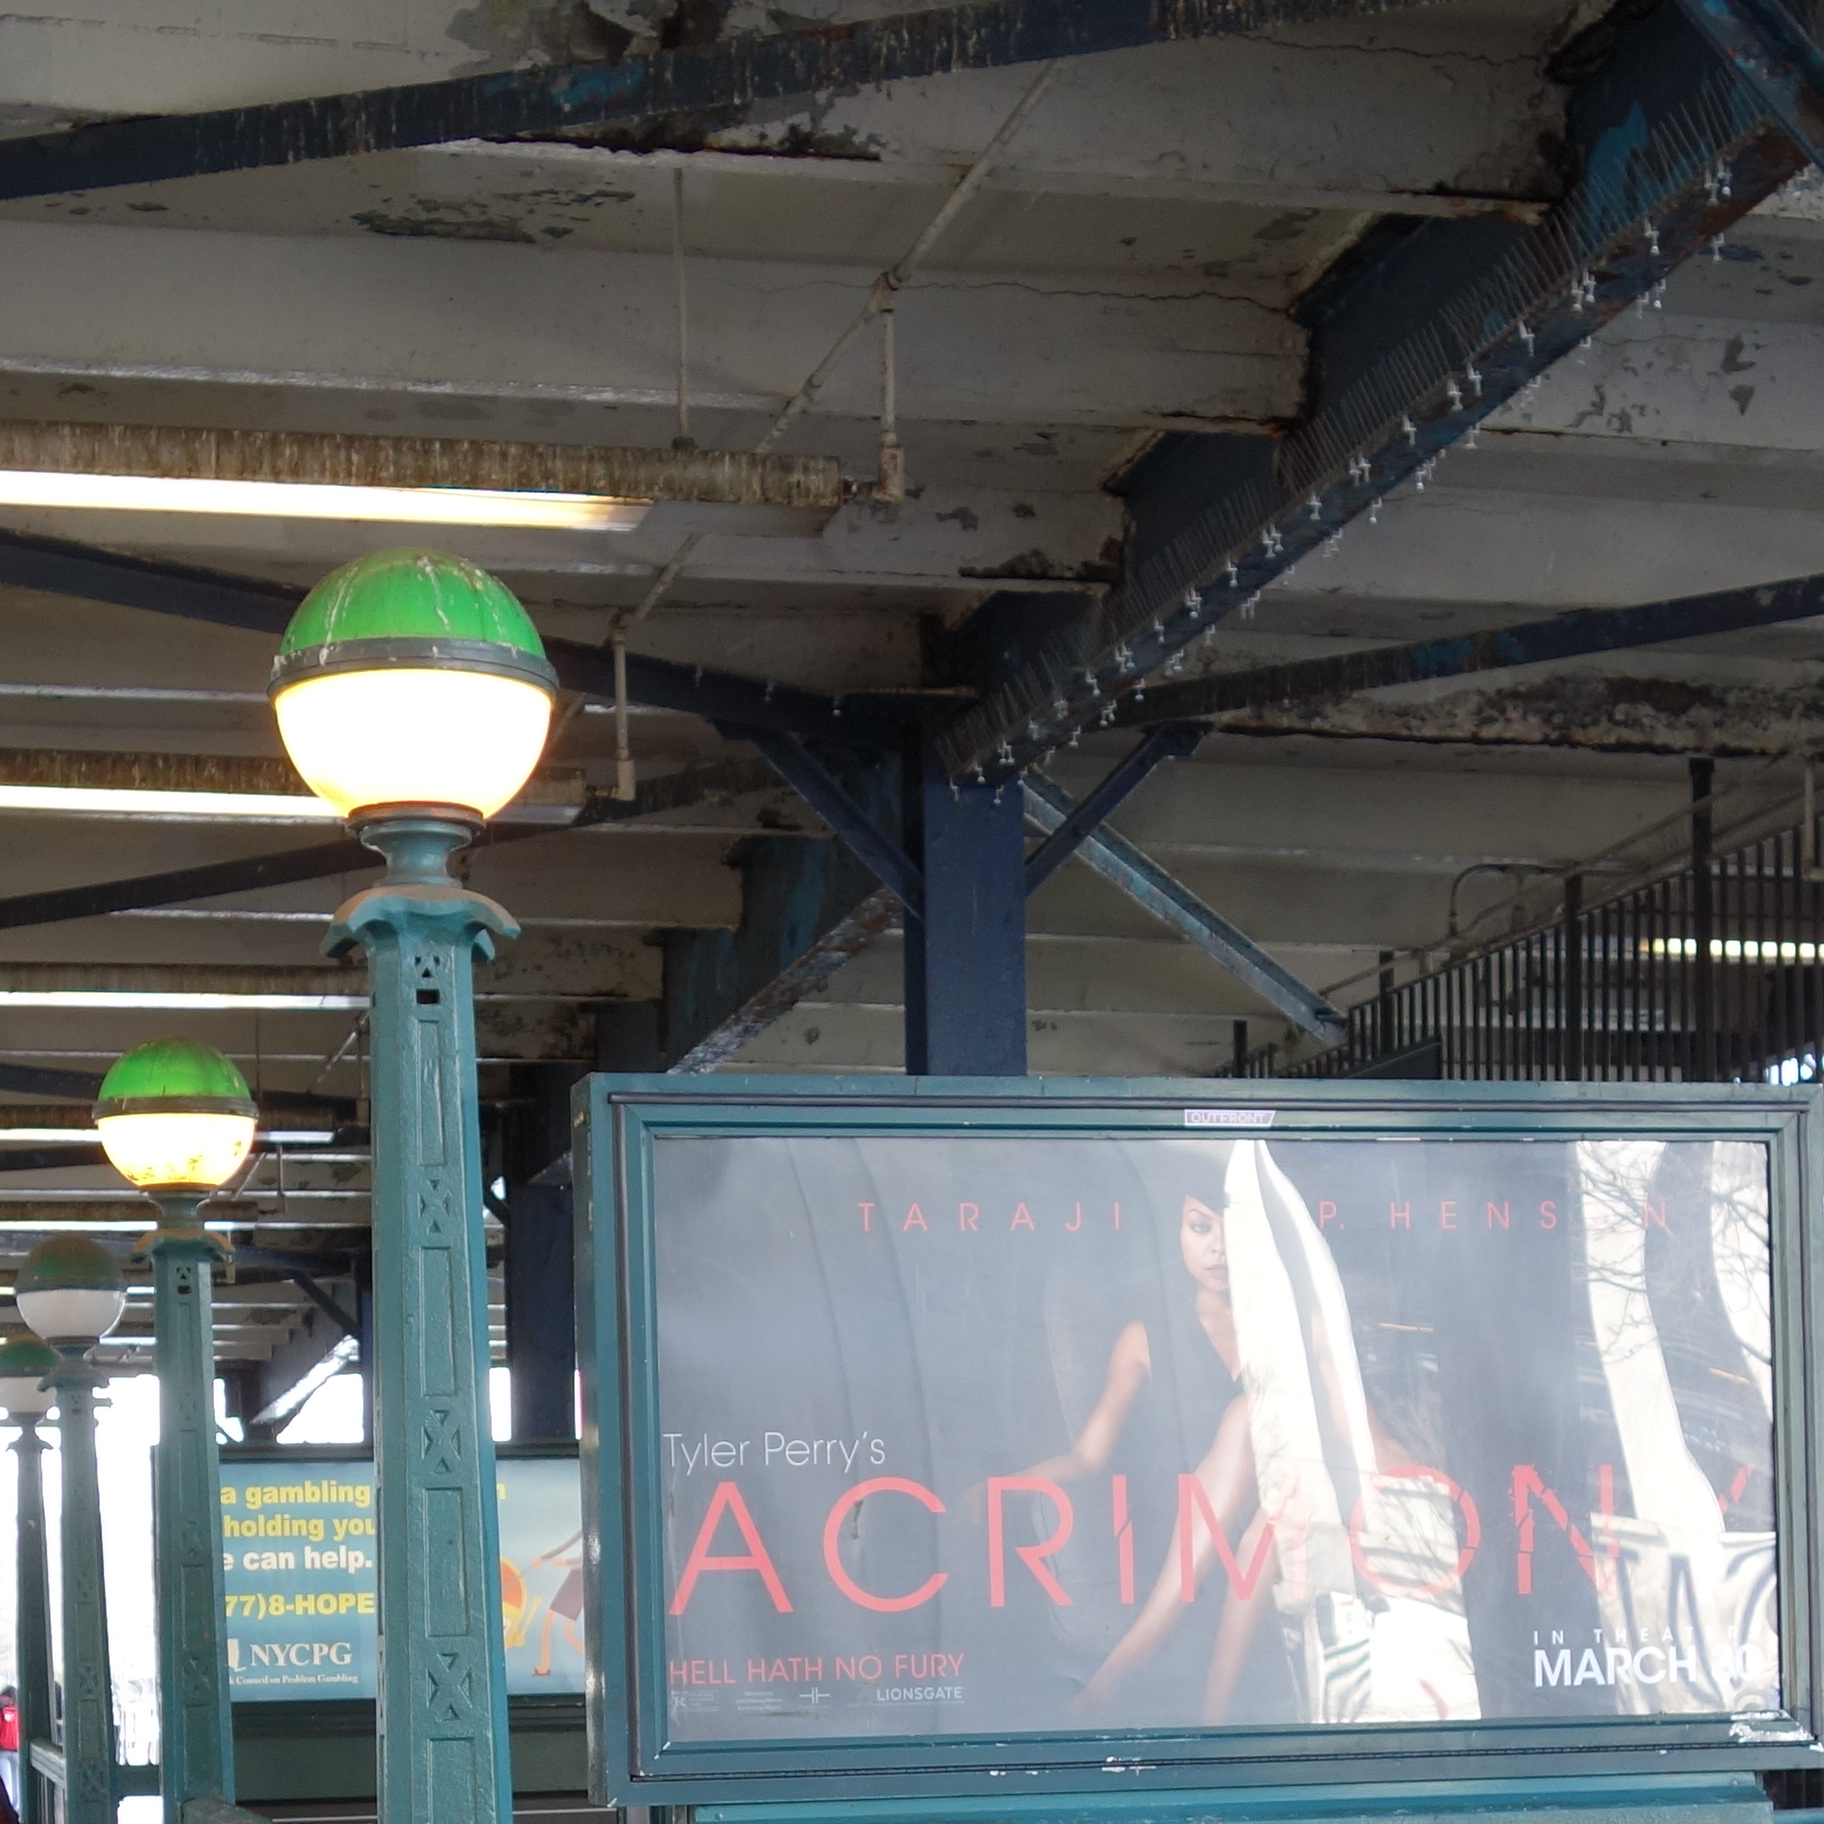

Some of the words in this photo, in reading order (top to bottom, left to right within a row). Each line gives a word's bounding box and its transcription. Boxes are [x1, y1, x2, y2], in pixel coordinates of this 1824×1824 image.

[1190, 1112, 1267, 1124] OUTFRONT
[857, 1202, 1121, 1233] TARAJI
[1389, 1200, 1667, 1232] HENSN
[663, 1433, 751, 1476] Tyler
[764, 1431, 886, 1474] Perry's
[245, 1480, 371, 1510] gambling
[224, 1514, 324, 1542] holding
[243, 1549, 295, 1570] can
[304, 1545, 372, 1573] help.
[1534, 1630, 1564, 1645] IN
[250, 1641, 352, 1667] NYCPG
[1534, 1645, 1697, 1687] MARCH
[235, 1675, 268, 1684] Council
[317, 1673, 359, 1685] Gambling
[668, 1659, 737, 1685] HELL
[747, 1656, 824, 1682] HATH
[835, 1655, 883, 1681] NO
[895, 1653, 965, 1679] FURY
[876, 1686, 963, 1701] LIONSGATE
